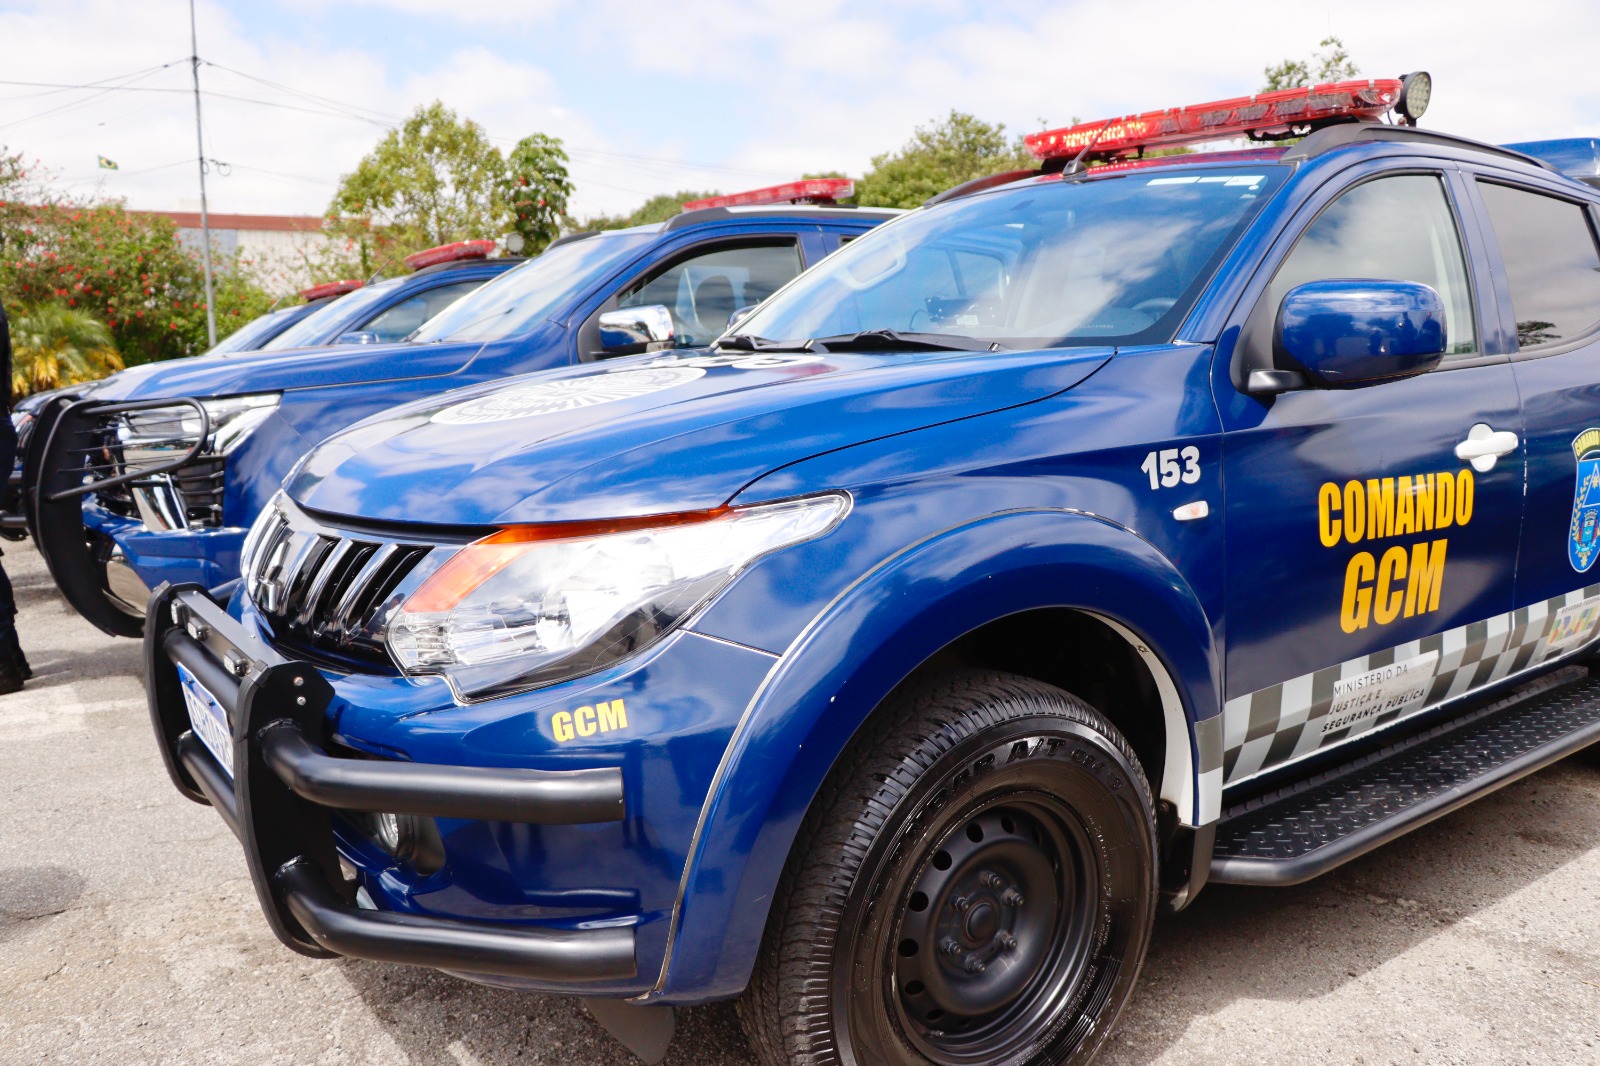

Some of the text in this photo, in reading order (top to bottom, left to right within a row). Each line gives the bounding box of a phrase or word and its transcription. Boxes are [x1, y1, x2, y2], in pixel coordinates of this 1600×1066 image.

[1140, 445, 1201, 490] 153
[1318, 468, 1475, 548] COMANDO
[1339, 538, 1448, 635] GCM
[1329, 688, 1382, 715] JUSTIÇA E
[1334, 664, 1408, 697] MINISTÉRIO DA
[551, 699, 628, 742] GCM
[1321, 688, 1425, 733] SEGURANÇA PÚBLICA
